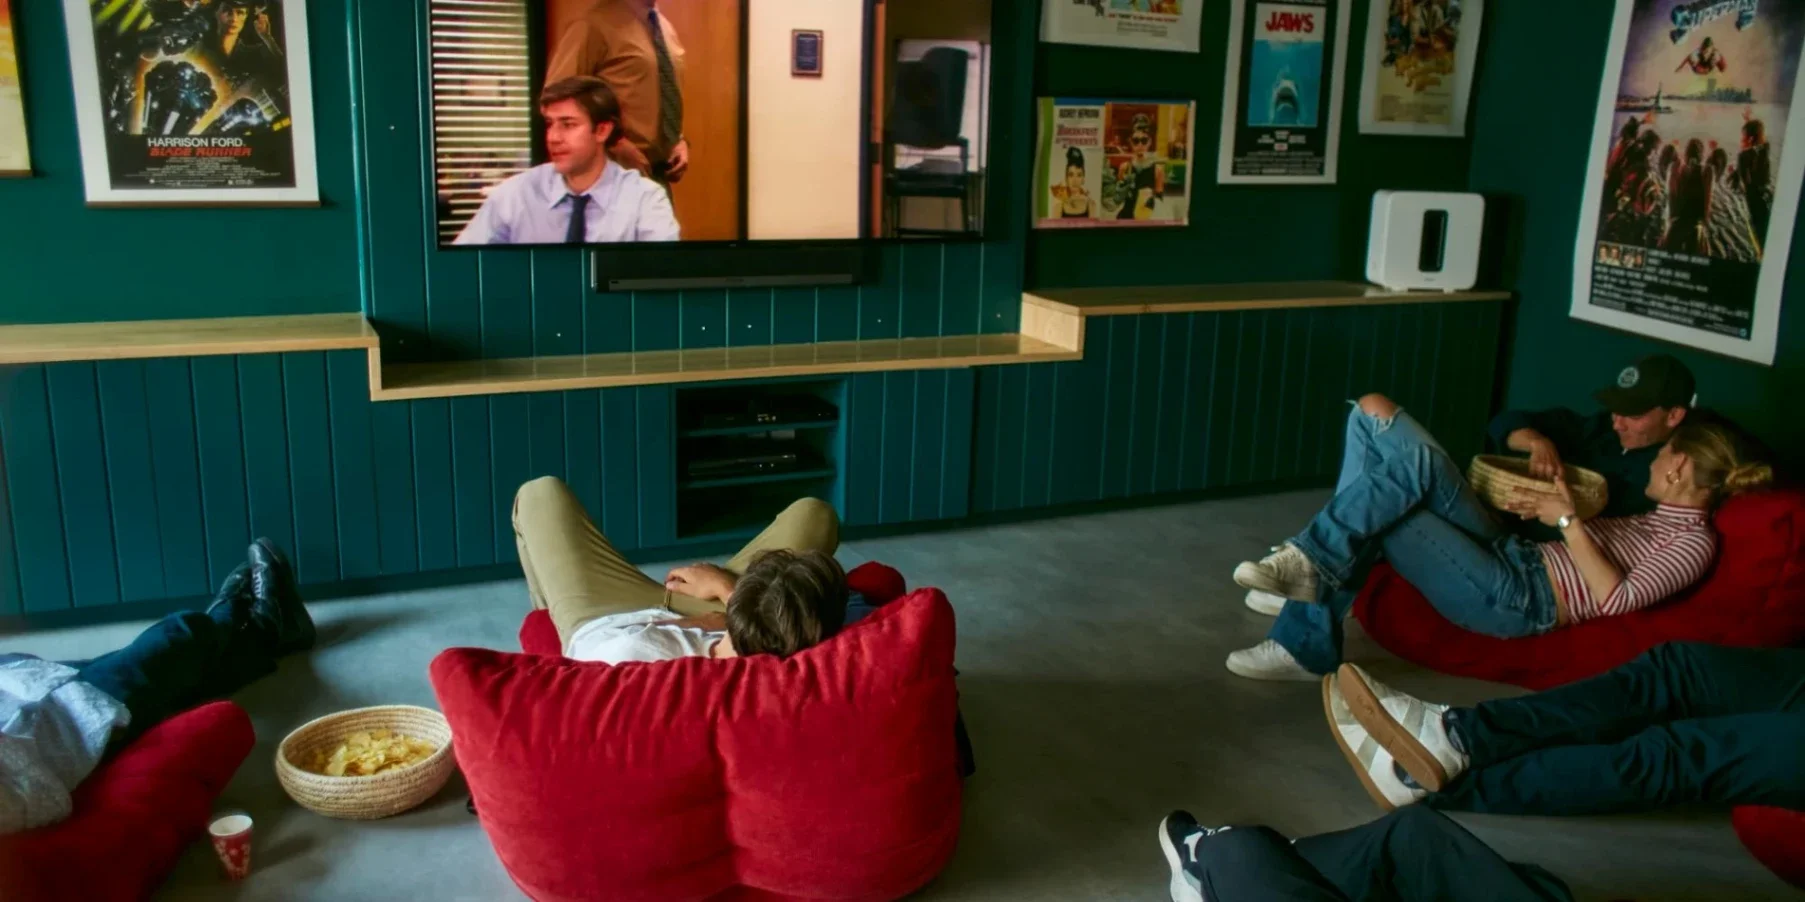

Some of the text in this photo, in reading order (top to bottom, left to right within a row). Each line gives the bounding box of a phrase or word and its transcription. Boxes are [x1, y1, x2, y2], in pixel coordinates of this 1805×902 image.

[1265, 11, 1314, 33] JAWS
[147, 137, 209, 147] HARRISON
[150, 147, 252, 158] BLADE RUNNER
